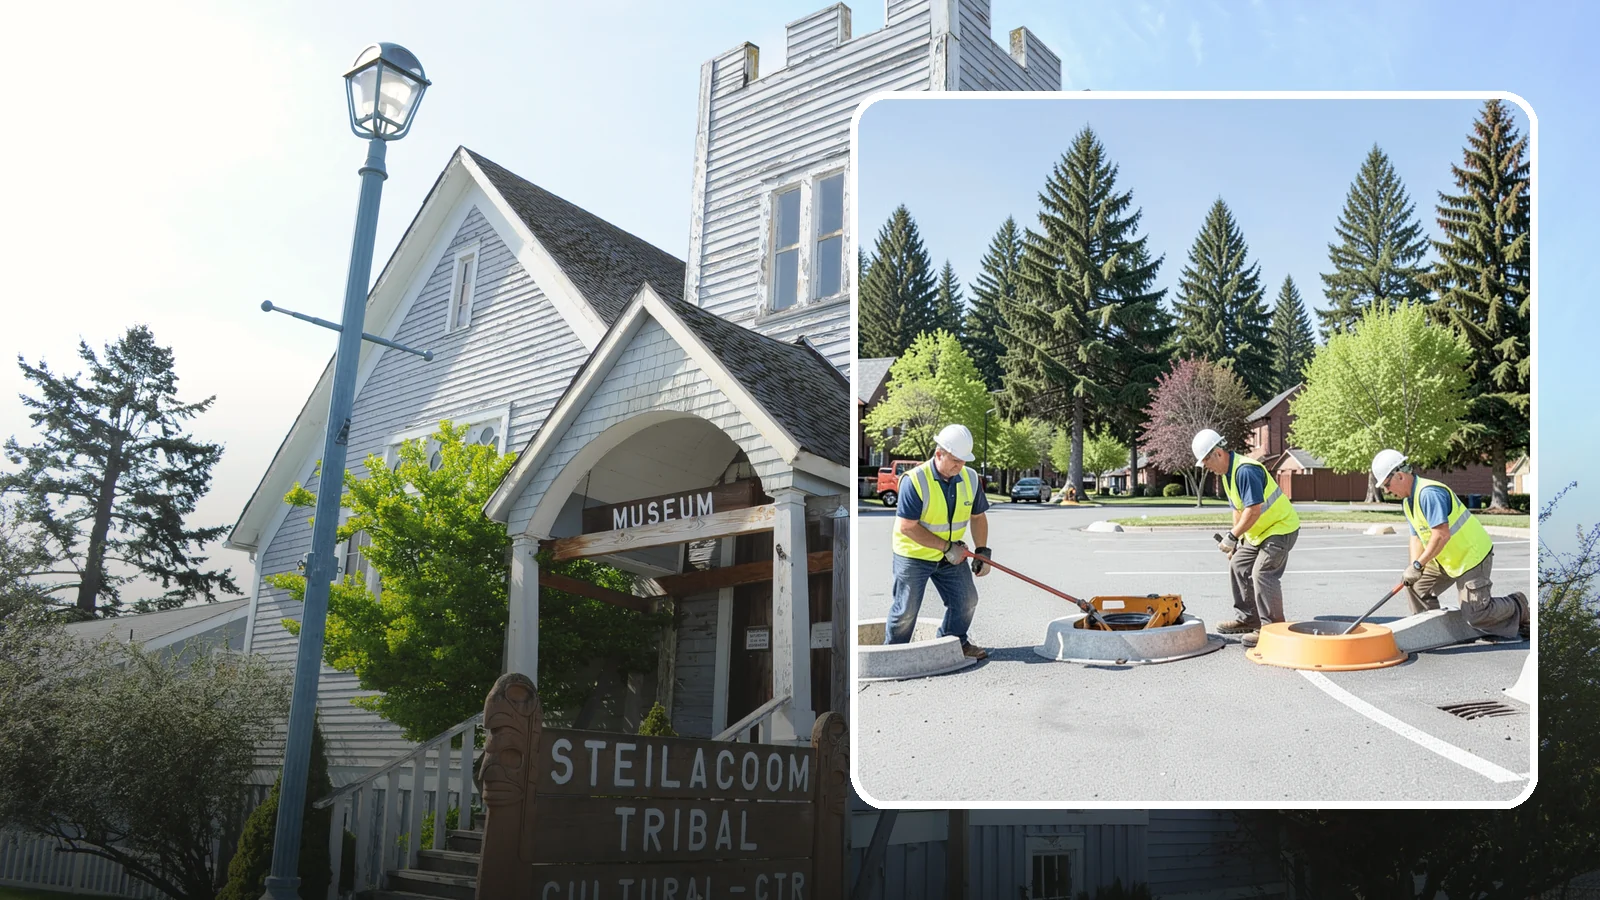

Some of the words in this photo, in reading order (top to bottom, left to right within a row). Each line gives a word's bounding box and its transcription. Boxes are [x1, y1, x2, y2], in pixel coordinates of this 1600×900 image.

[613, 492, 713, 530] MUSEUM
[550, 738, 809, 792] STEILACOOM
[614, 806, 757, 851] TRIBAL
